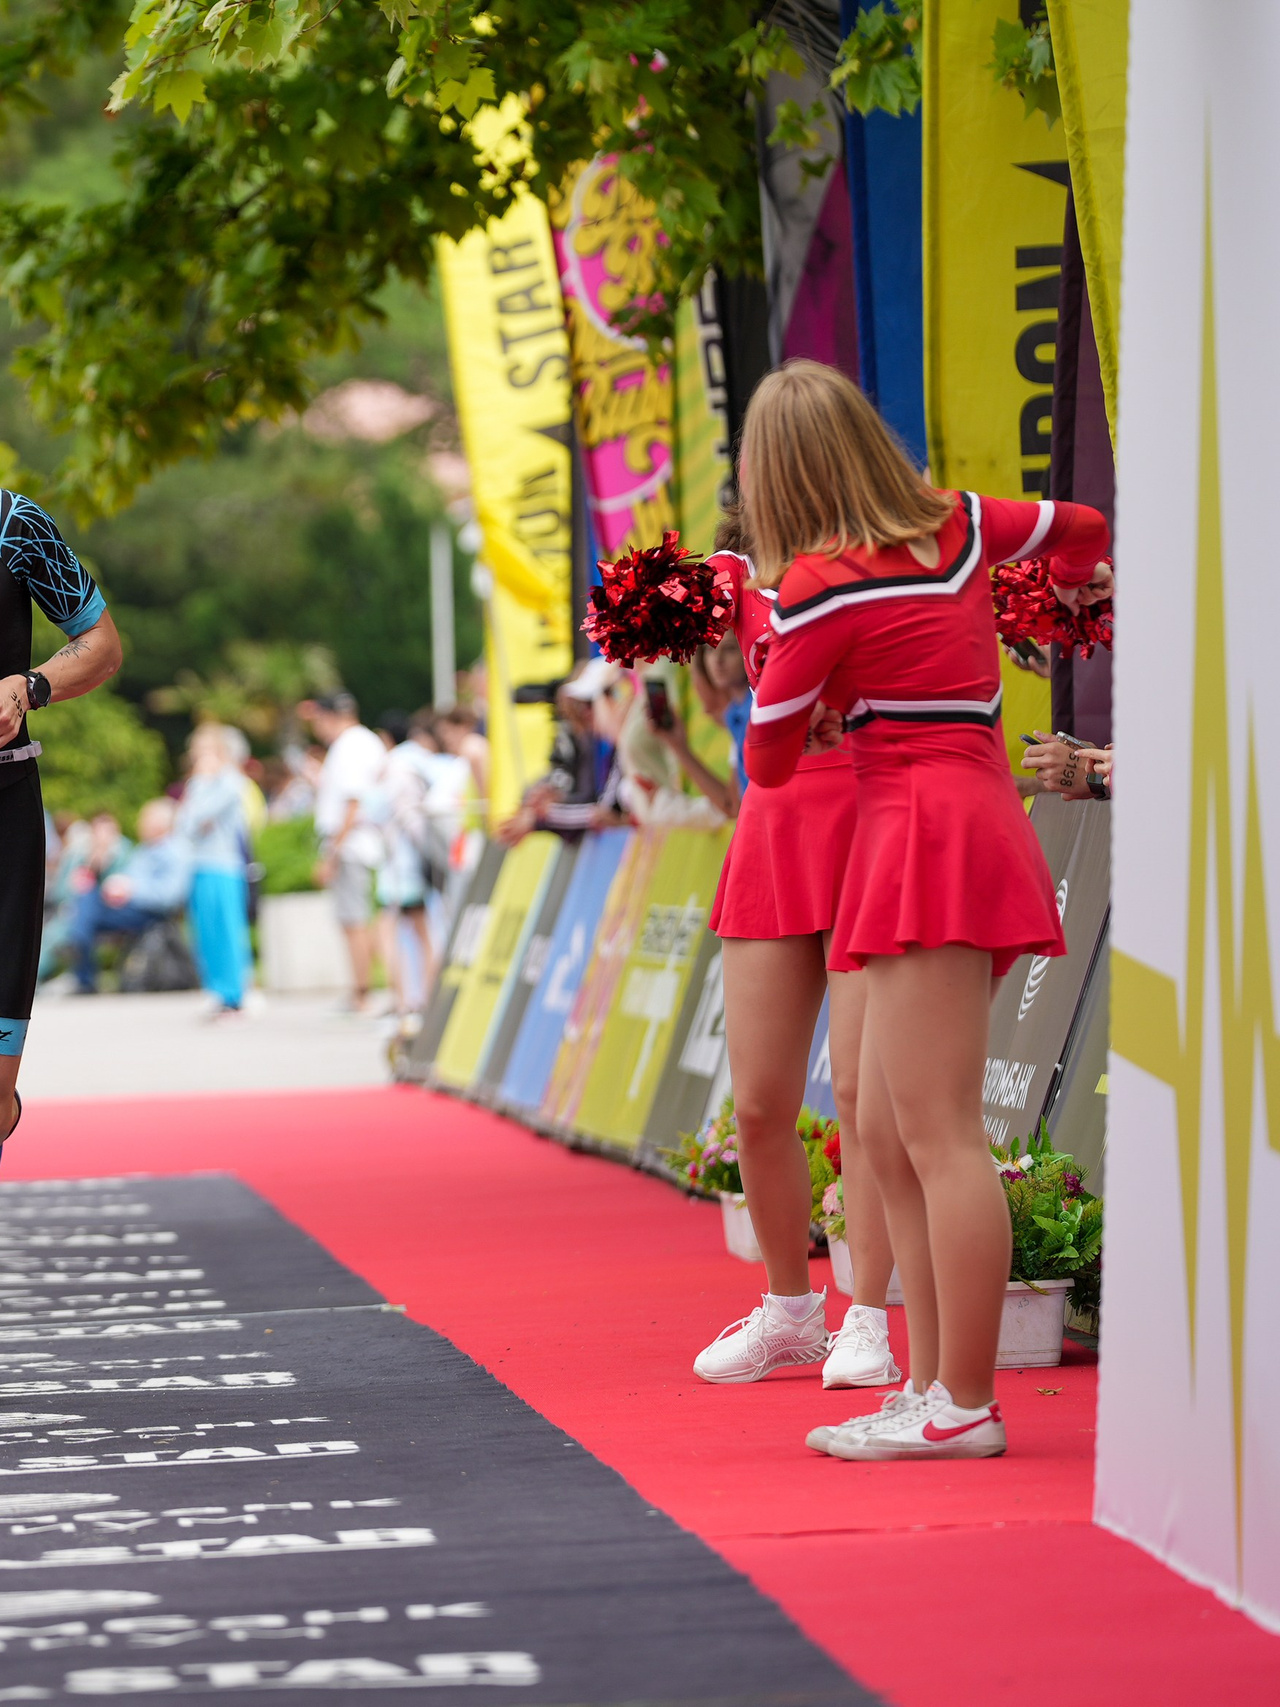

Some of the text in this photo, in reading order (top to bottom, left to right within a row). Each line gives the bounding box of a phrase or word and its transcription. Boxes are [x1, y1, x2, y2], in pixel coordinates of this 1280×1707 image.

[488, 237, 570, 390] STAR
[18, 1440, 360, 1469] STAR
[41, 1527, 438, 1561] STAR
[67, 1651, 539, 1695] STAR
